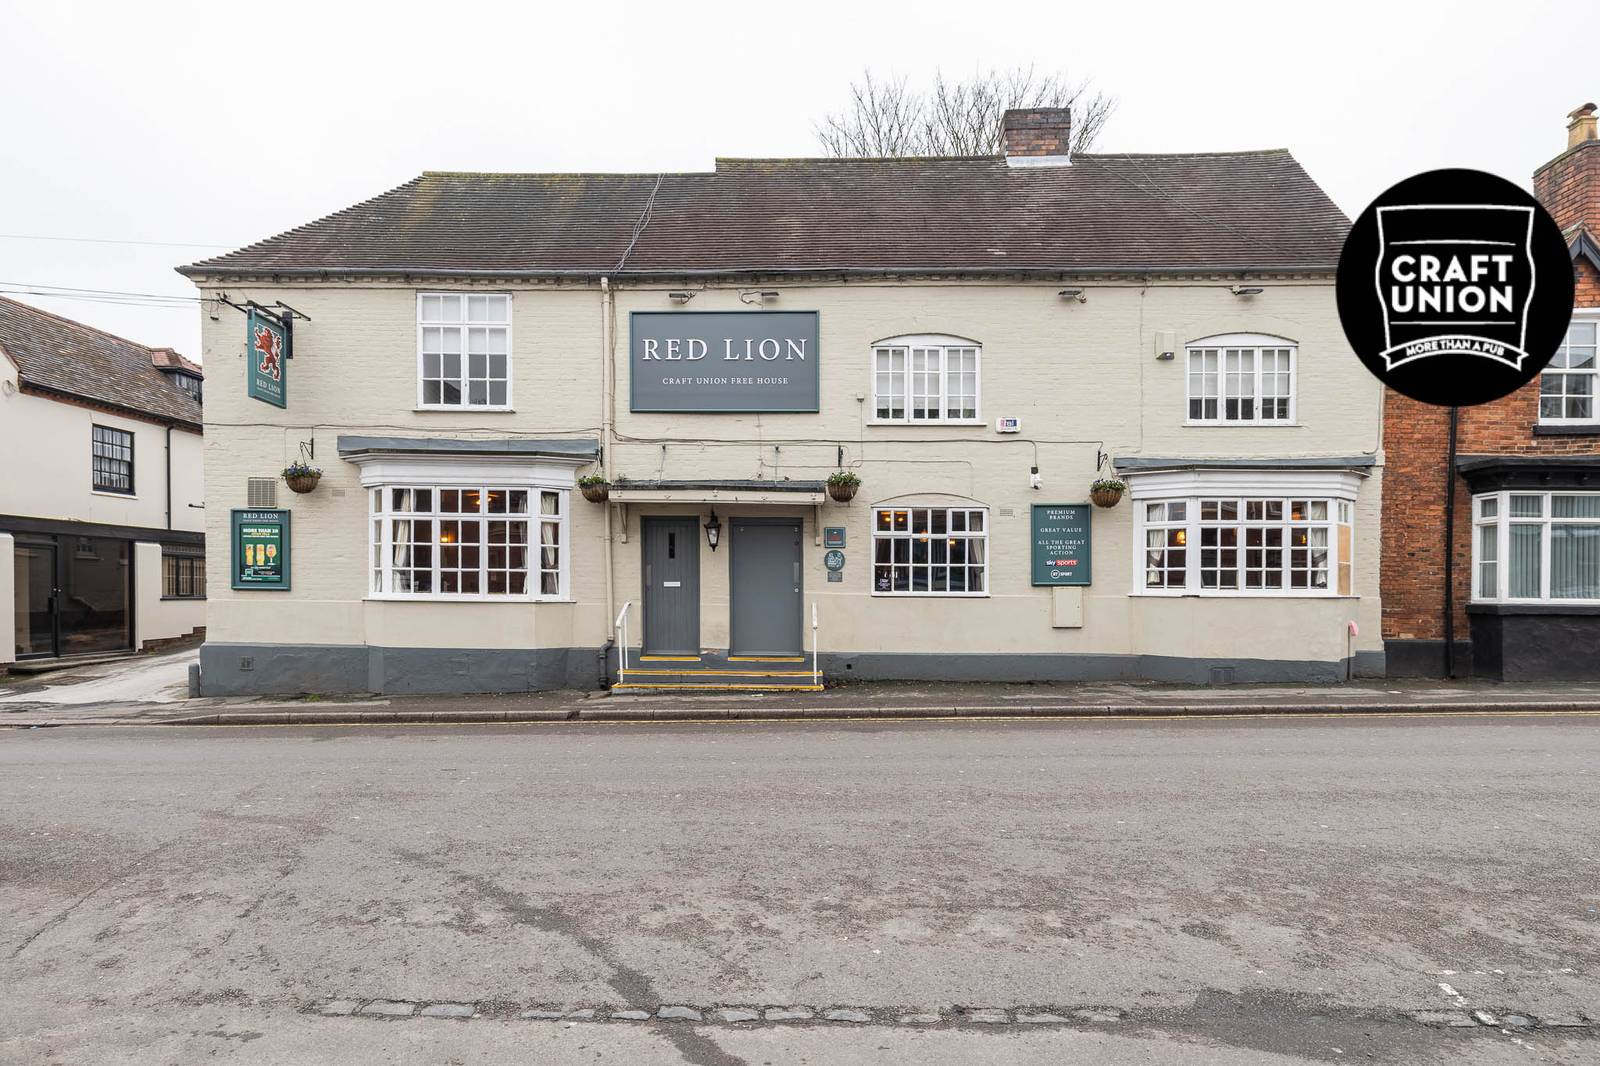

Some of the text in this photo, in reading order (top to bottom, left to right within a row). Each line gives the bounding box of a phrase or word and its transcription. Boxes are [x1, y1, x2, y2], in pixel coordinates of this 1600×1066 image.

[642, 338, 807, 361] RED LION
[256, 378, 267, 389] RED
[268, 383, 281, 394] LION
[662, 377, 789, 385] CRAFT UNION FREE HOUSE
